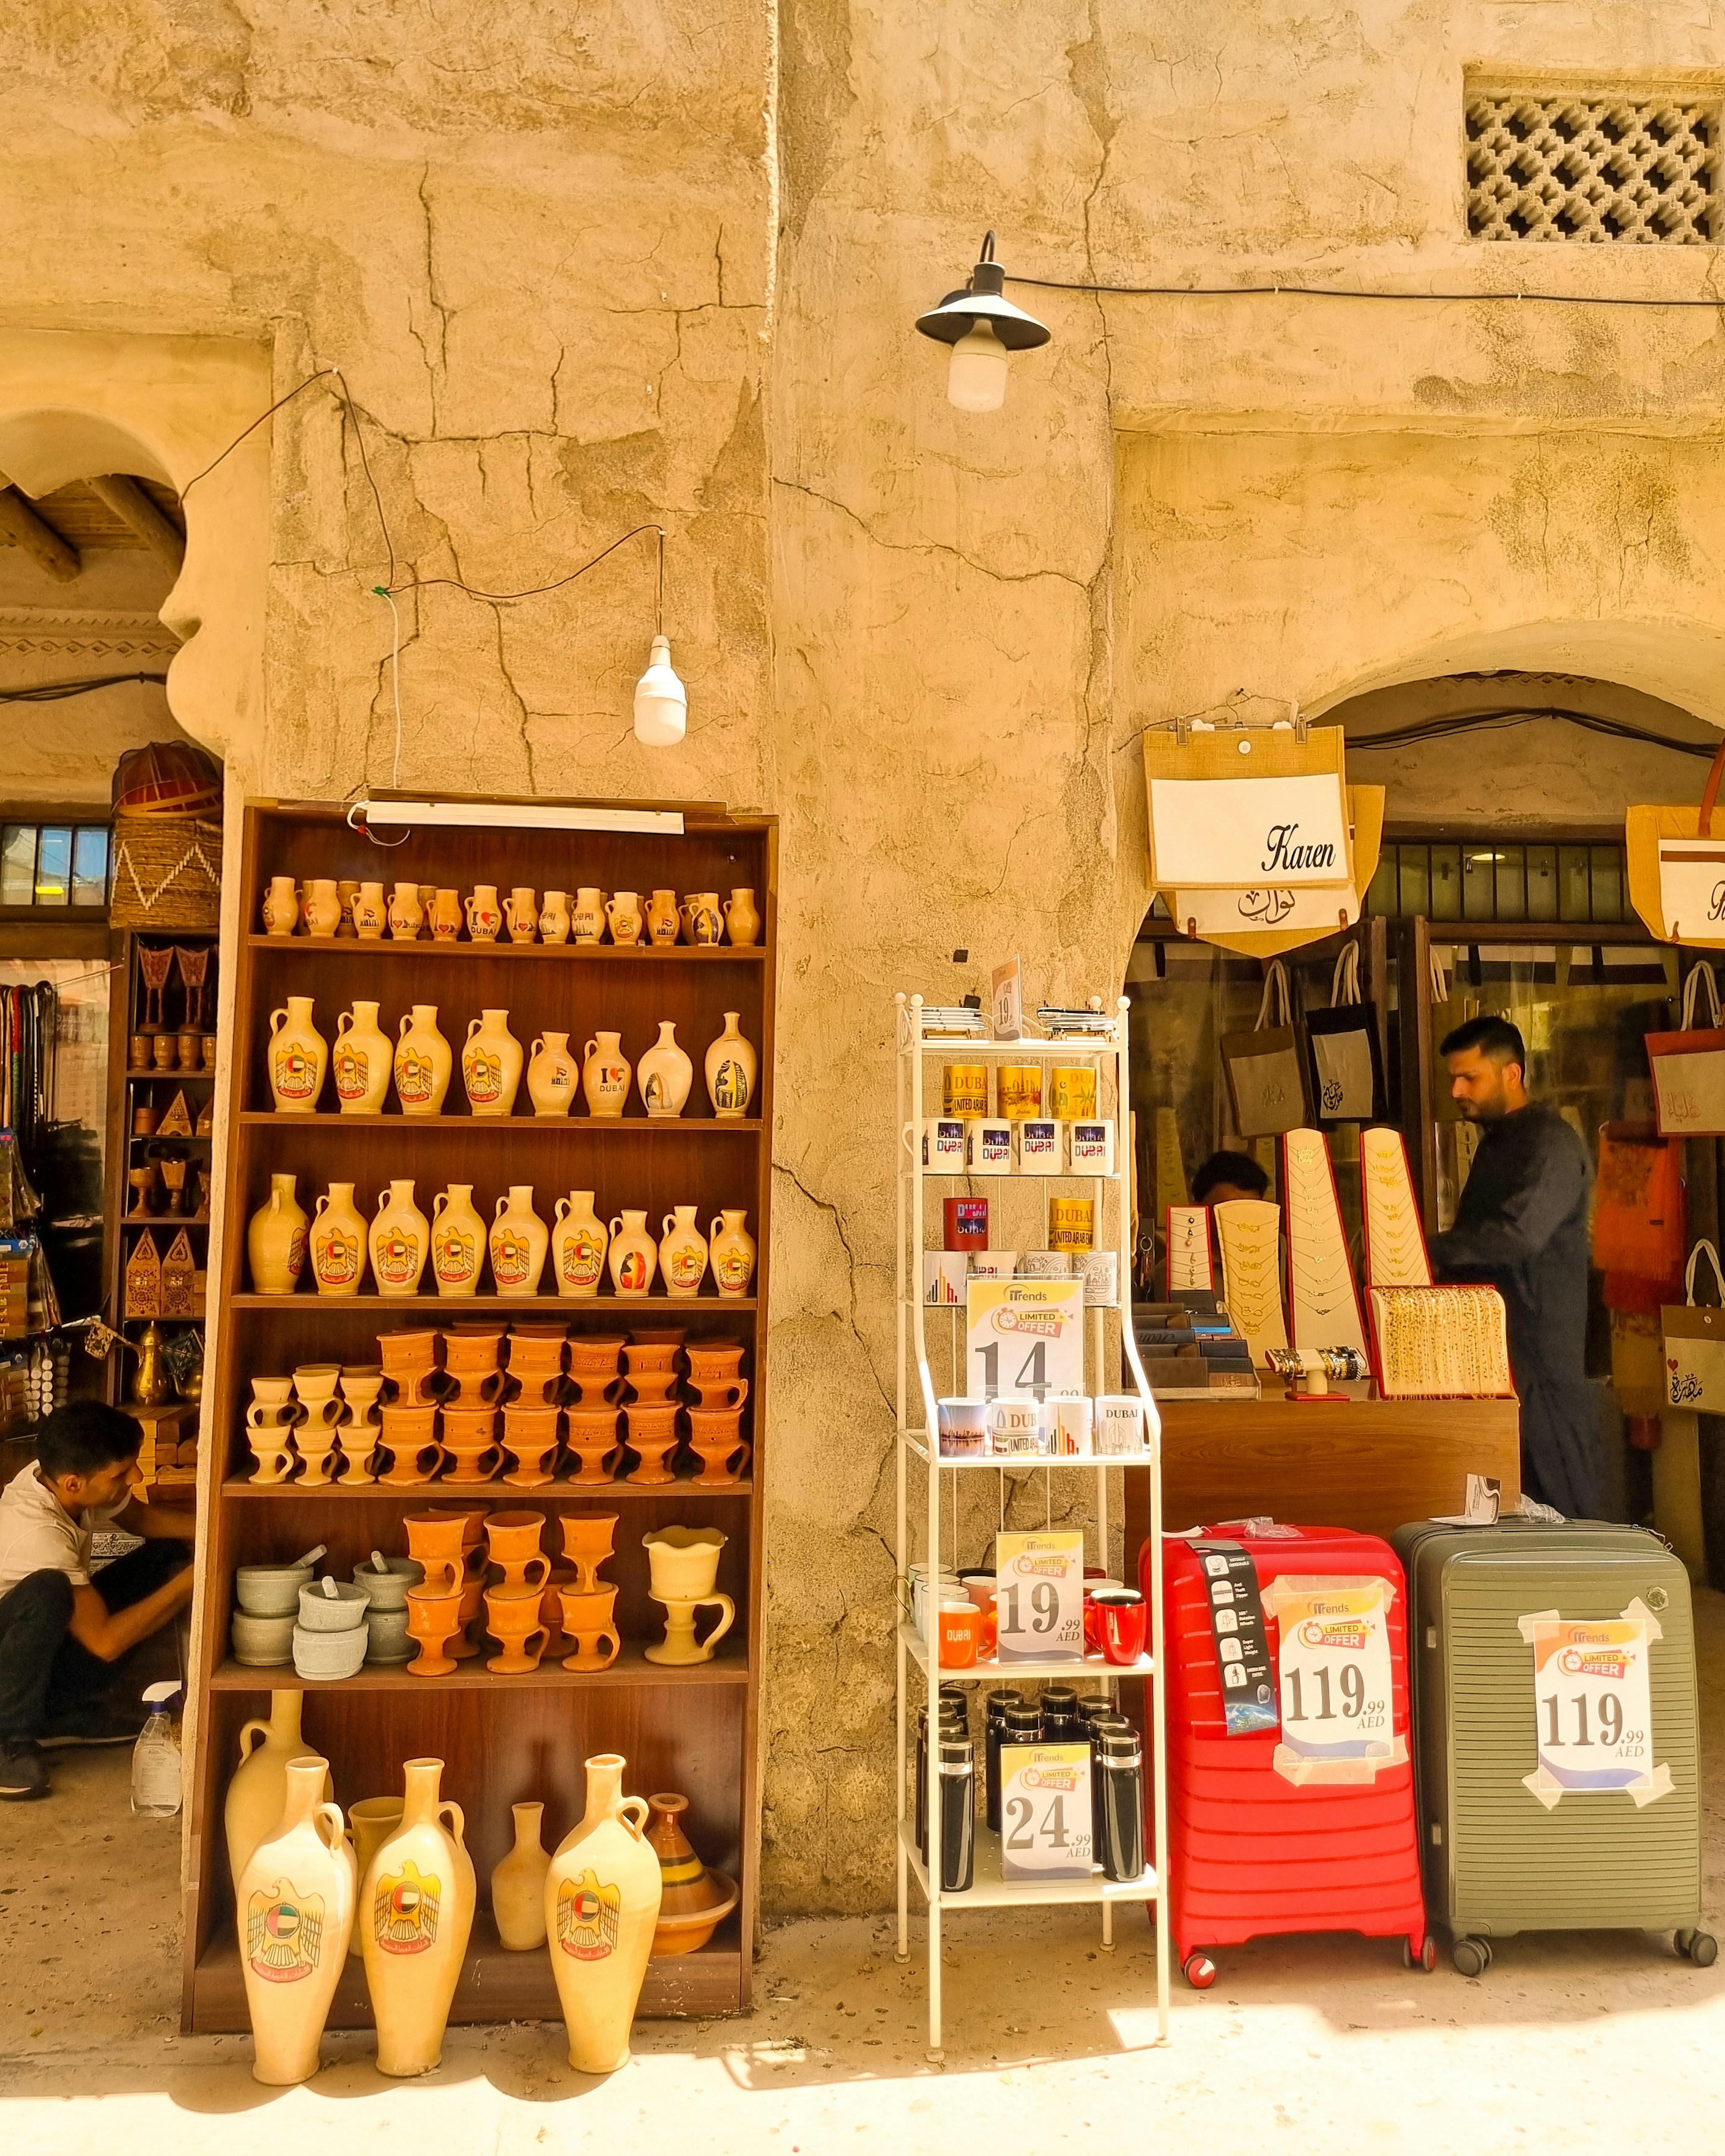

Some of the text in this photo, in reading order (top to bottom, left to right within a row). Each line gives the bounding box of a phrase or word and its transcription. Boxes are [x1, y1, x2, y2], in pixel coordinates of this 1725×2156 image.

[1261, 823, 1336, 872] Karen
[471, 927, 497, 935] DUBAI
[954, 1098, 973, 1111] UNITED
[1025, 1141, 1054, 1154] DUBAI
[1075, 1145, 1105, 1158] DUBAI
[1056, 1209, 1092, 1223] DUBAI
[1055, 1231, 1072, 1243] UNITED
[1072, 1232, 1085, 1245] ARAB
[1010, 1290, 1047, 1301] iTrends
[1018, 1322, 1056, 1335] OFFER
[1106, 1409, 1138, 1418] DUBAI
[1011, 1438, 1029, 1452] UNITED
[1026, 1541, 1055, 1550] iTrends
[1033, 1566, 1062, 1576] OFFER
[1313, 1603, 1349, 1614] iTrends
[947, 1629, 971, 1642] DUBAI
[1325, 1625, 1359, 1634] LIMITED
[1056, 1631, 1080, 1642] AED
[1324, 1634, 1359, 1647] OFFER
[1574, 1632, 1609, 1643] iTrends
[1582, 1663, 1619, 1676] OFFER
[1357, 1716, 1385, 1729] AED
[1615, 1746, 1644, 1757] AED
[1041, 1779, 1071, 1789] OFFER
[1066, 1847, 1091, 1858] AED
